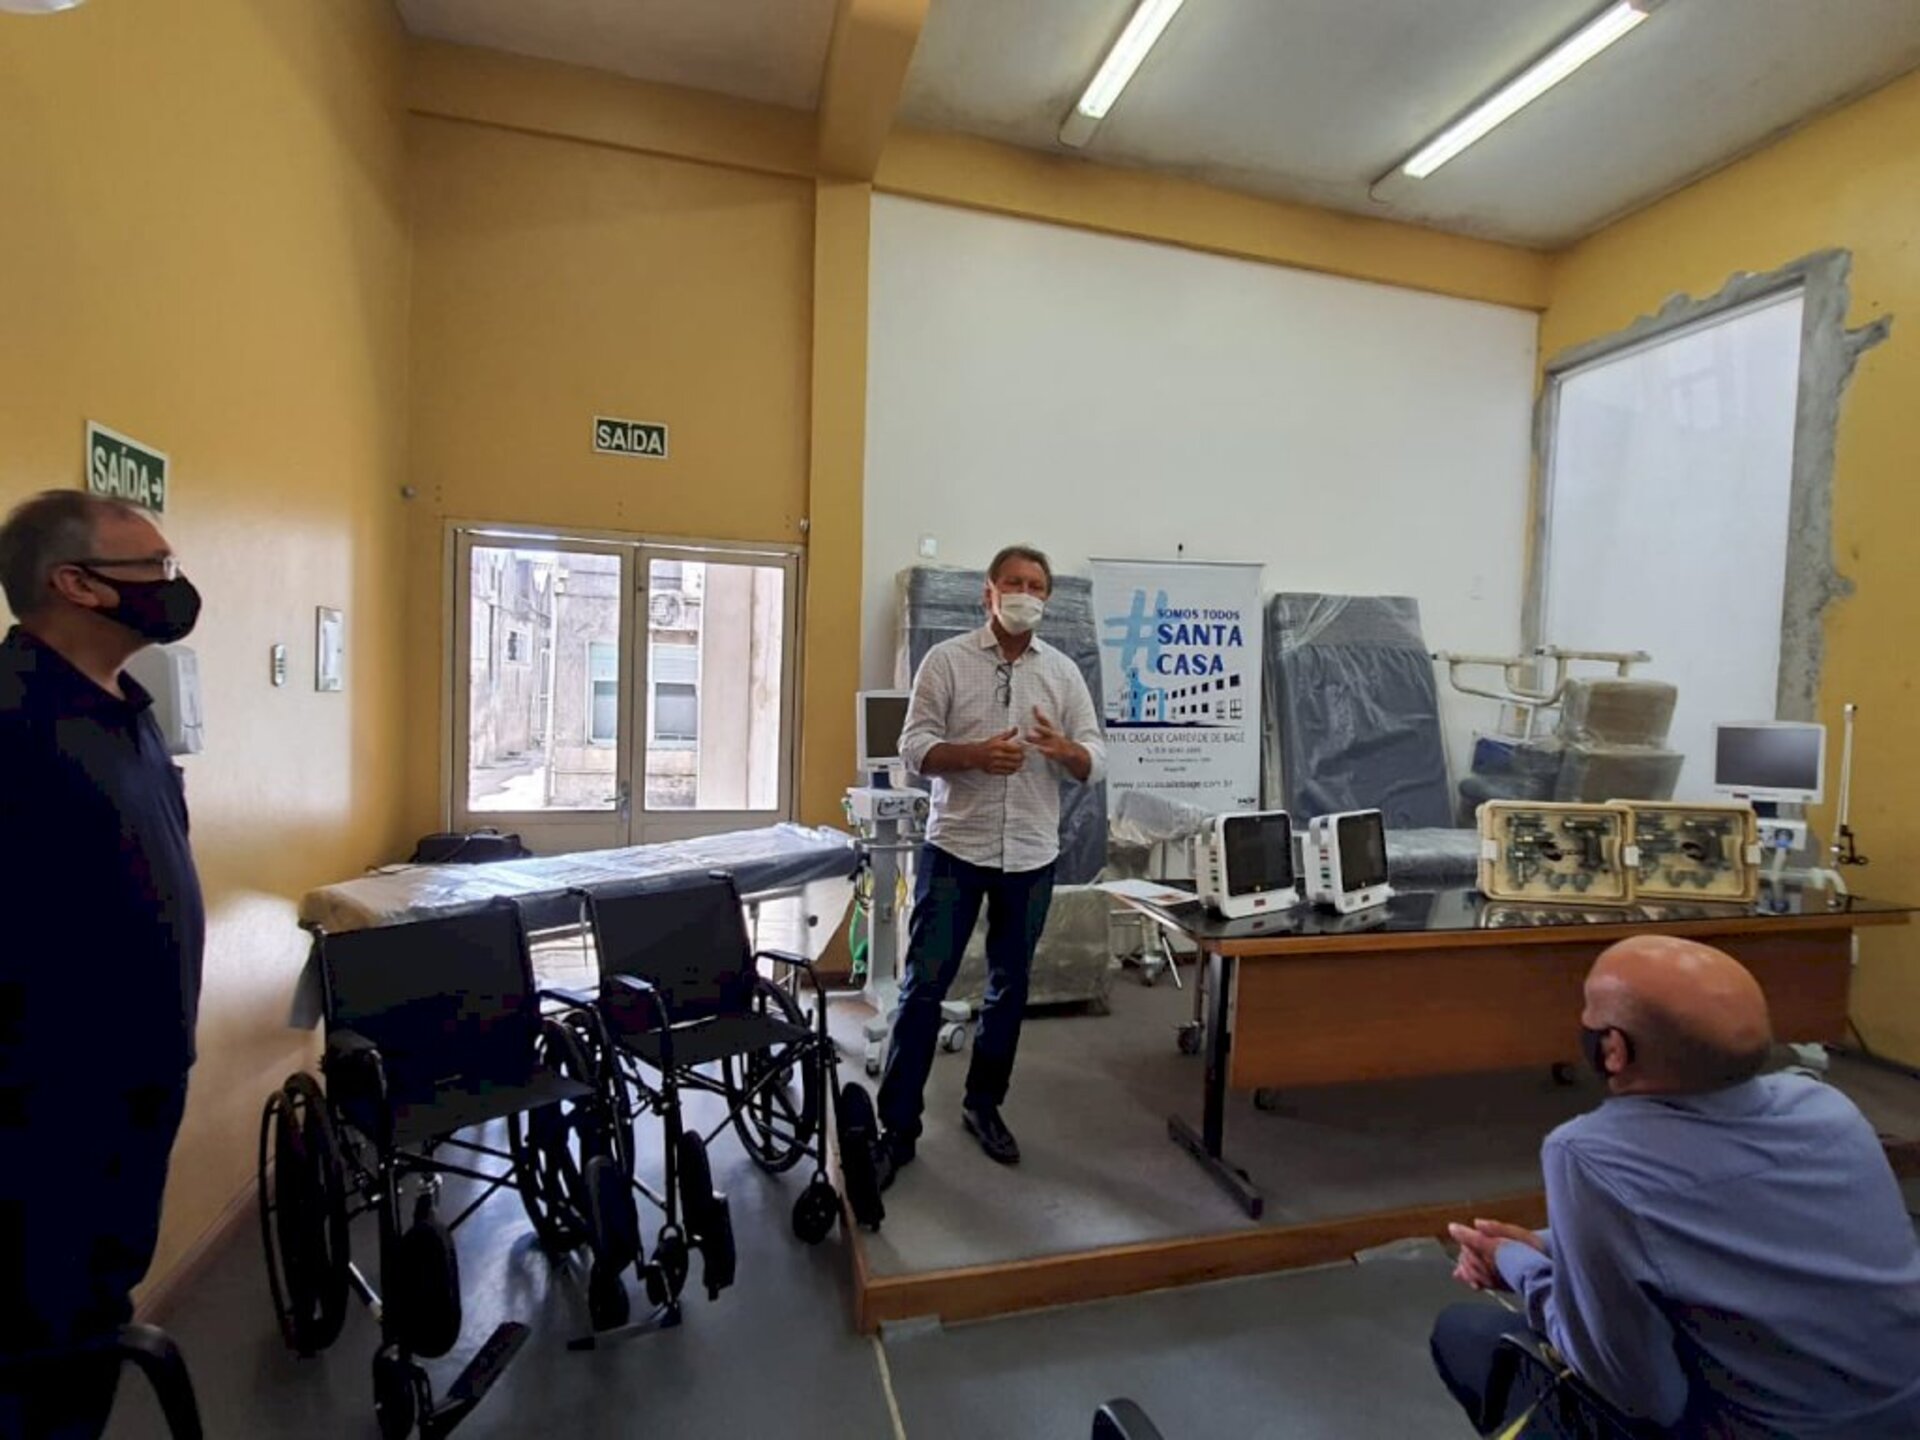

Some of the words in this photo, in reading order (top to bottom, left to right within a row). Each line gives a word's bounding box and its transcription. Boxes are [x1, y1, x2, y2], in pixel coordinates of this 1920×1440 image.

[597, 422, 663, 453] SAÍDA
[93, 445, 151, 507] SAÍDA
[1157, 608, 1199, 620] SOMOS
[1203, 609, 1240, 621] TODOS
[1157, 623, 1243, 648] SANTA
[1156, 653, 1224, 676] CASA
[1103, 732, 1127, 743] ANTA
[1128, 732, 1152, 743] CASA
[1153, 732, 1165, 743] DE
